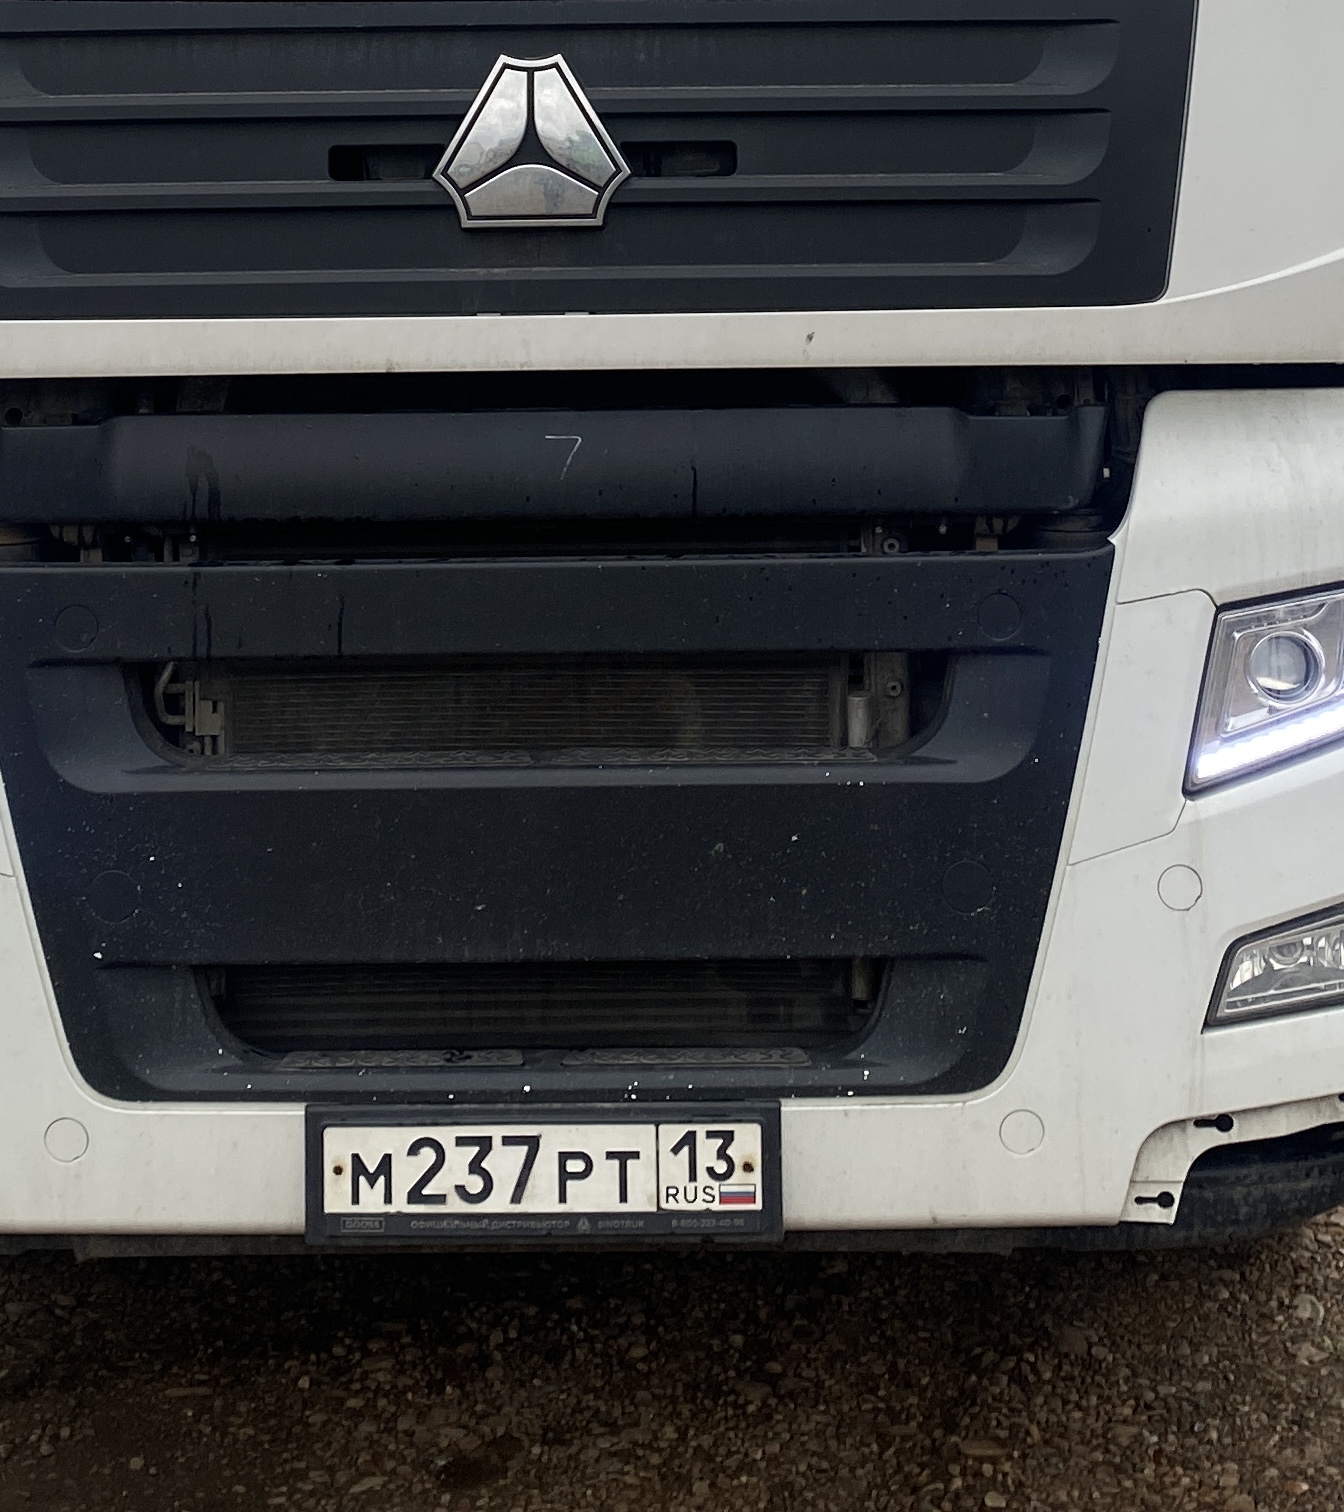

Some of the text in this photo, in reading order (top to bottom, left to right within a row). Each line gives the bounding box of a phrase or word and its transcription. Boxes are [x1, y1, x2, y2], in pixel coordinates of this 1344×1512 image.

[545, 435, 582, 480] 7
[350, 1130, 736, 1205] М237РТ 13
[665, 1185, 716, 1205] RUS
